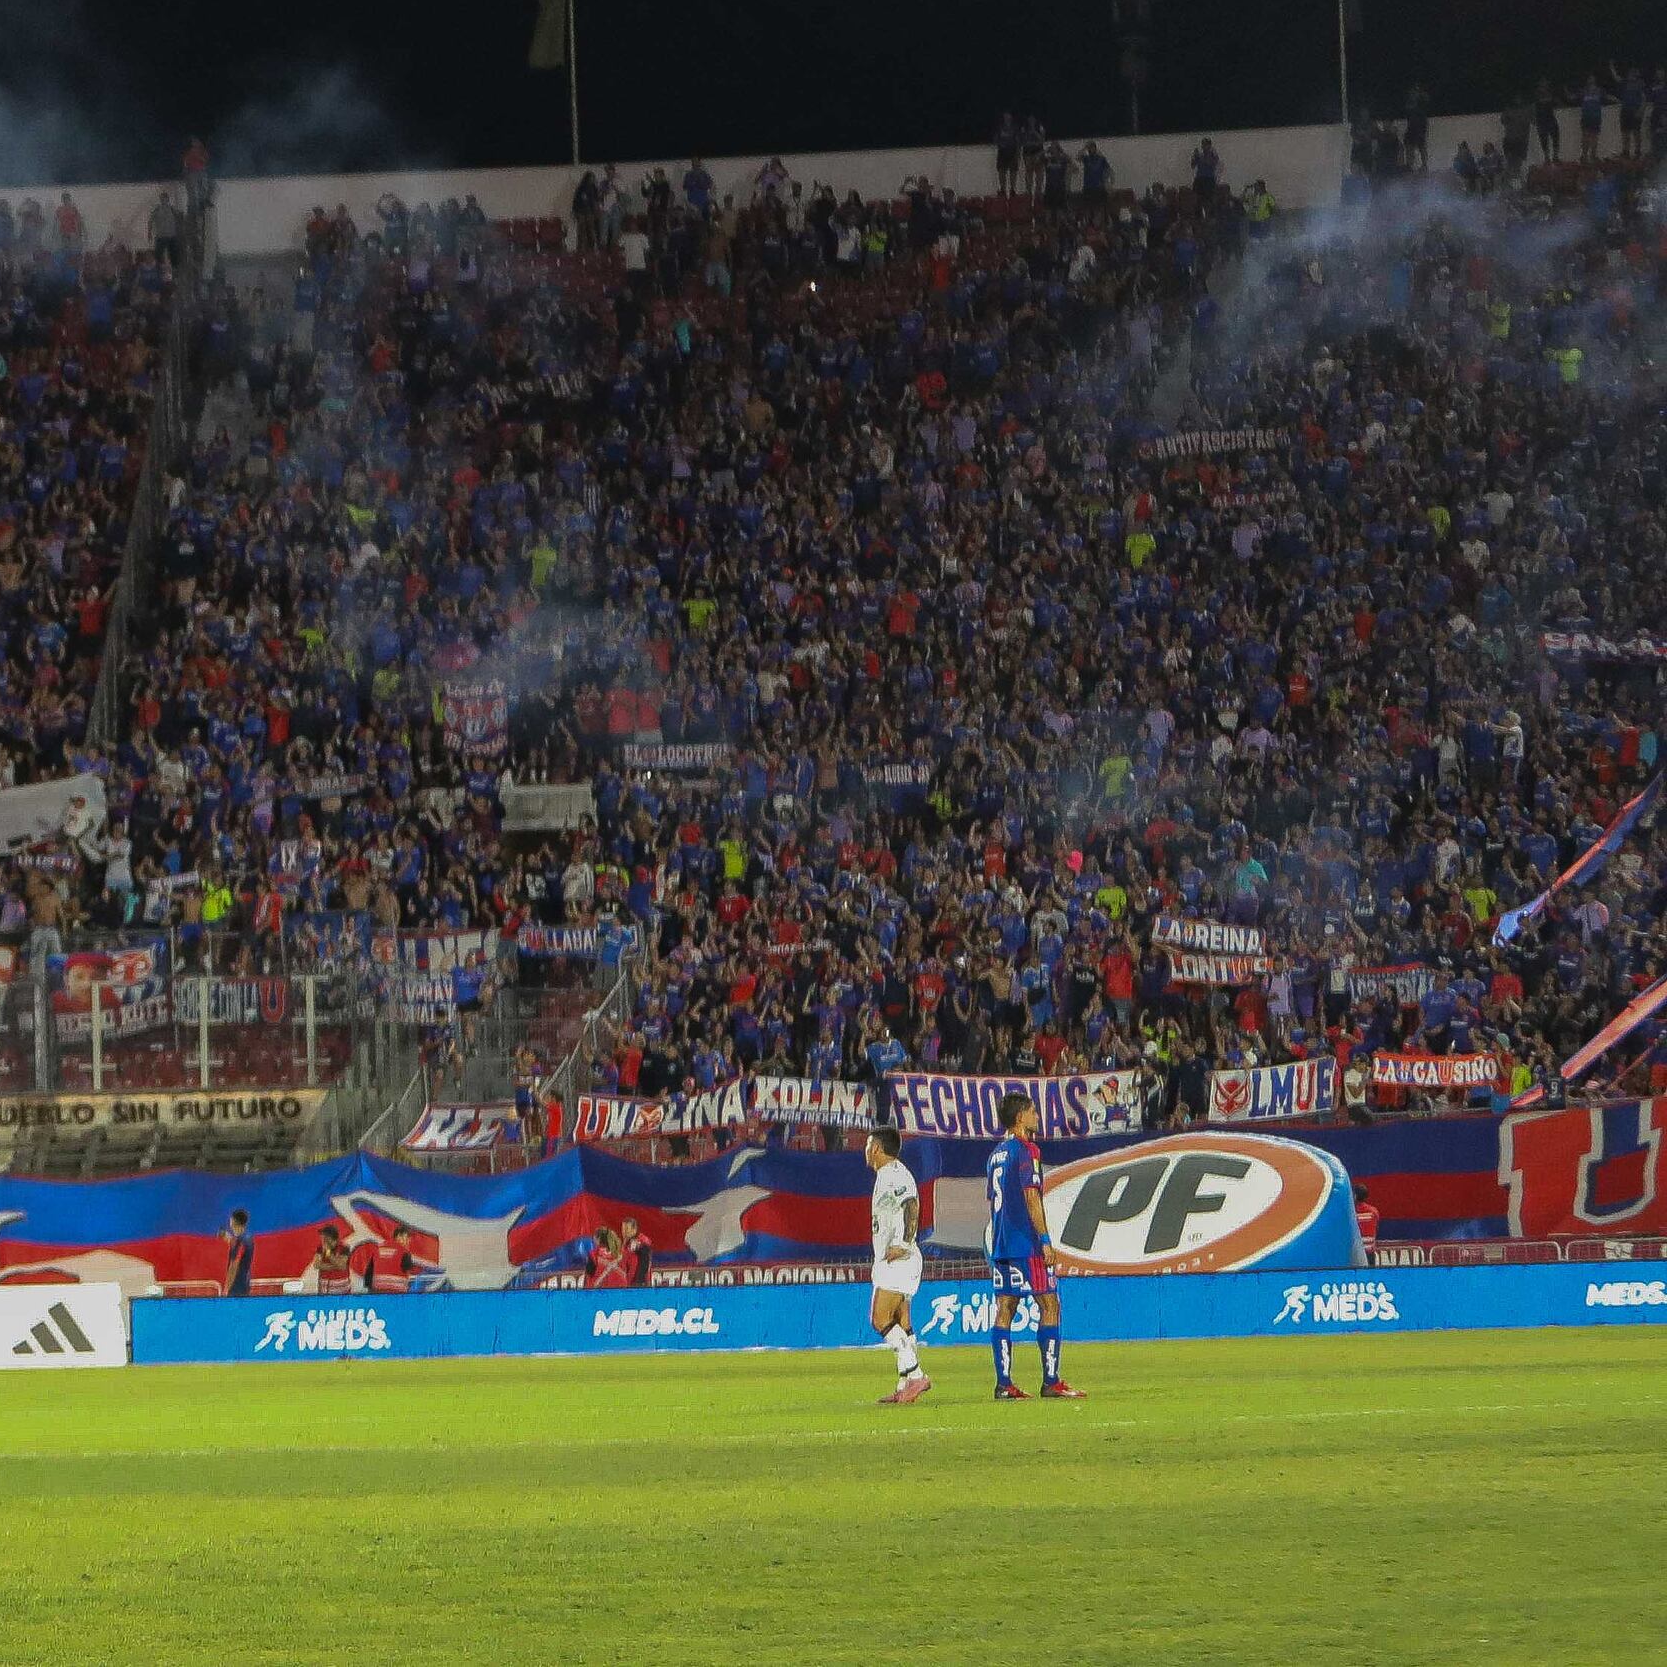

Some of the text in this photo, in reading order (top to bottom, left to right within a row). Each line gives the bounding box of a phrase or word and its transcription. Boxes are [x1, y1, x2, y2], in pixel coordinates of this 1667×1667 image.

[1152, 917, 1181, 944] LA
[112, 1101, 159, 1122] SIN
[179, 1097, 302, 1121] FUTURO
[890, 1075, 1091, 1140] FECHOIAS
